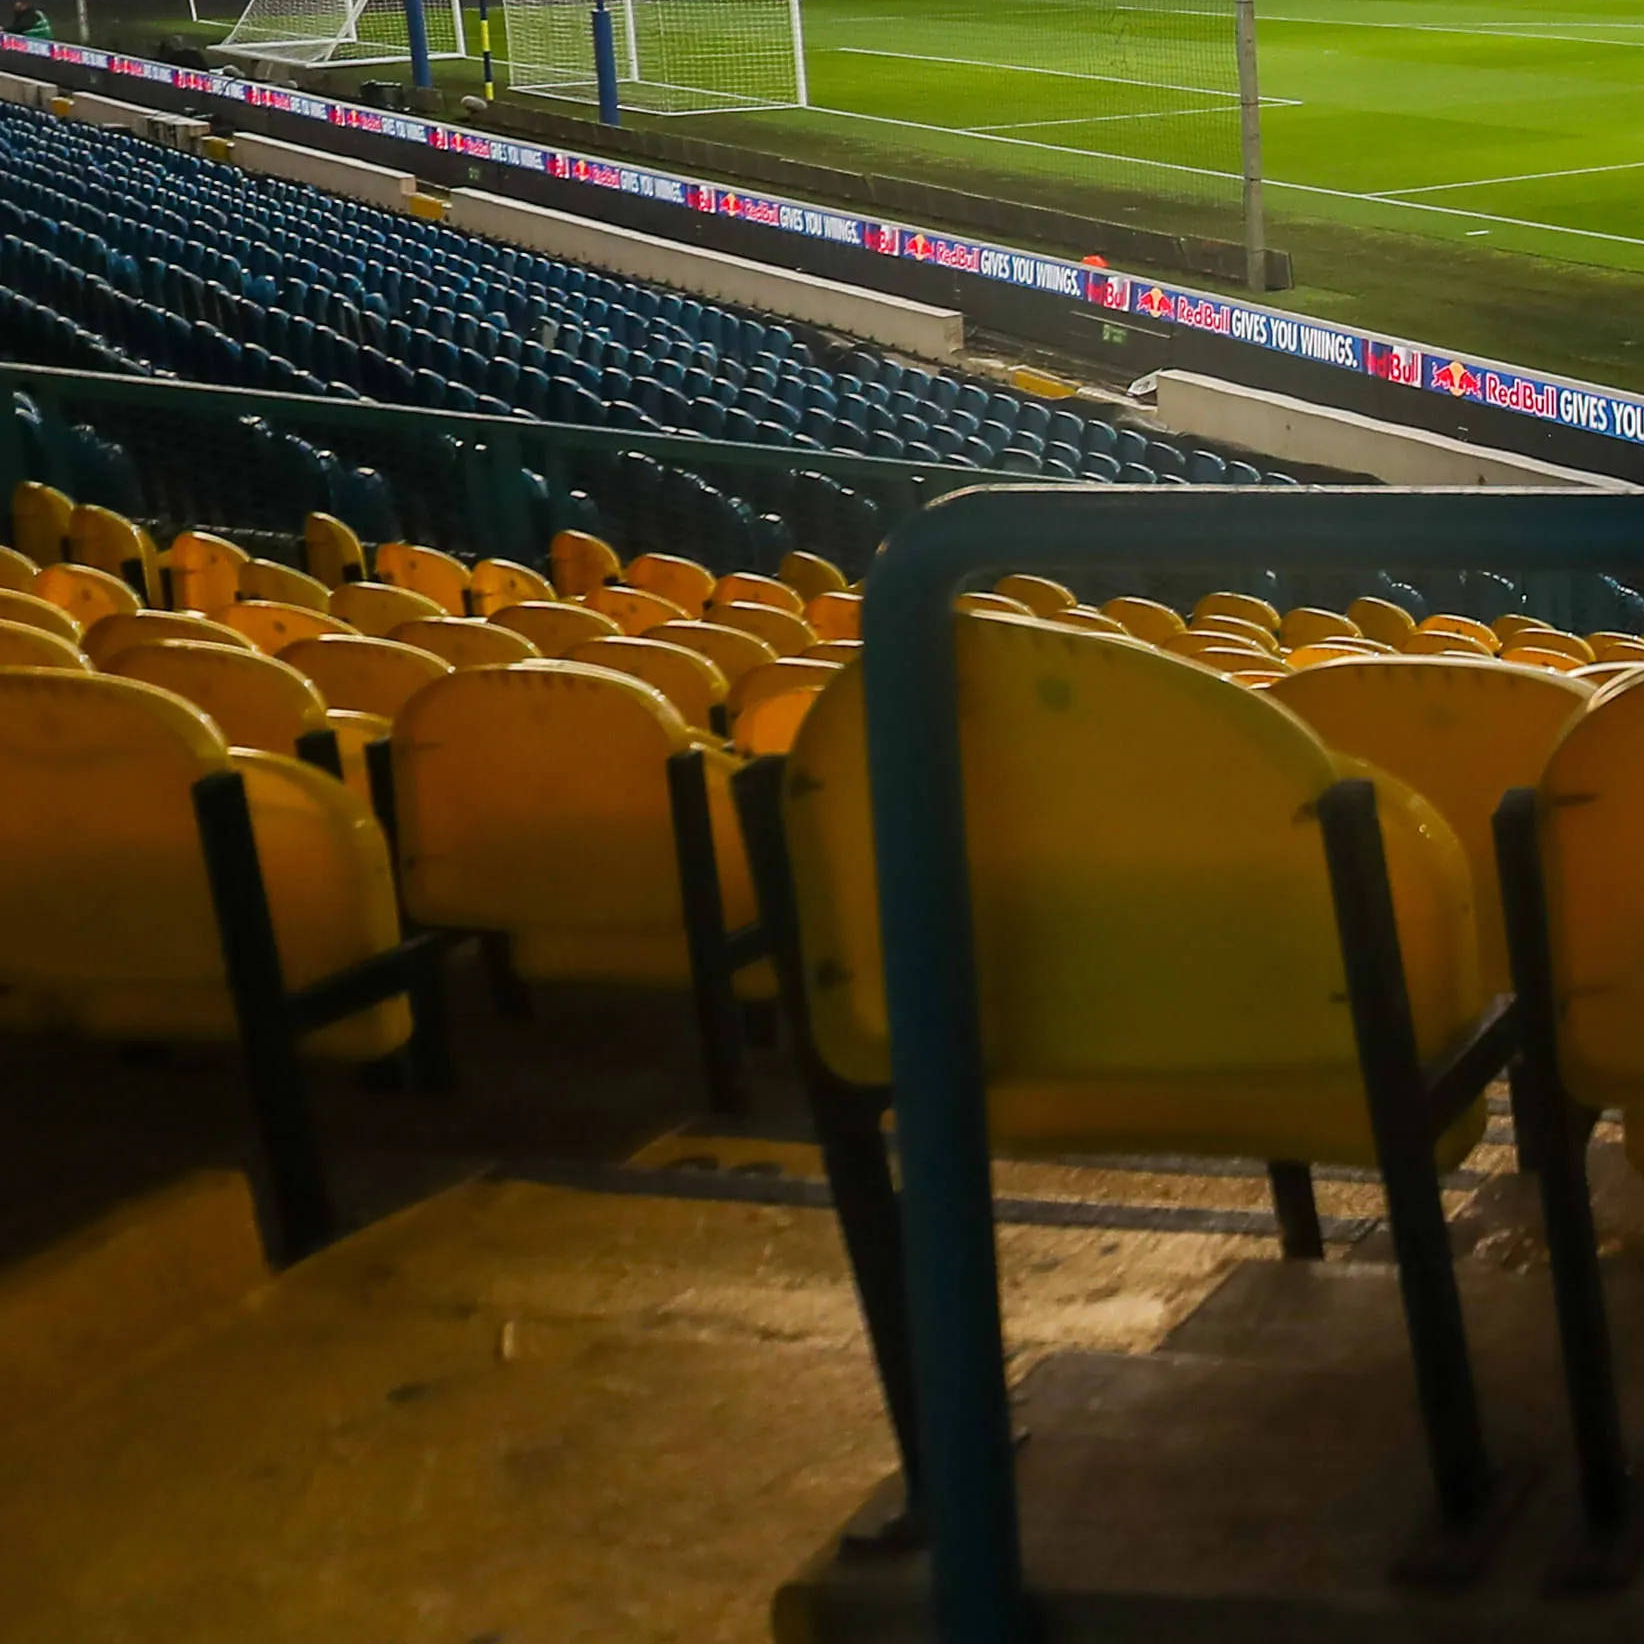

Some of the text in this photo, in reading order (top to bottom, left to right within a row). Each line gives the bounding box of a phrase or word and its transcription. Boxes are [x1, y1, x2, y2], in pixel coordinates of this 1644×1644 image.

[779, 204, 804, 231] GIVES
[803, 209, 823, 234] YOU
[980, 248, 1010, 280] GIVES
[1011, 254, 1035, 285] YOU
[1231, 308, 1267, 344] GIVES
[1269, 316, 1298, 352] YOU
[1300, 325, 1358, 368] WIIINGS.
[1559, 389, 1607, 432] GIVES
